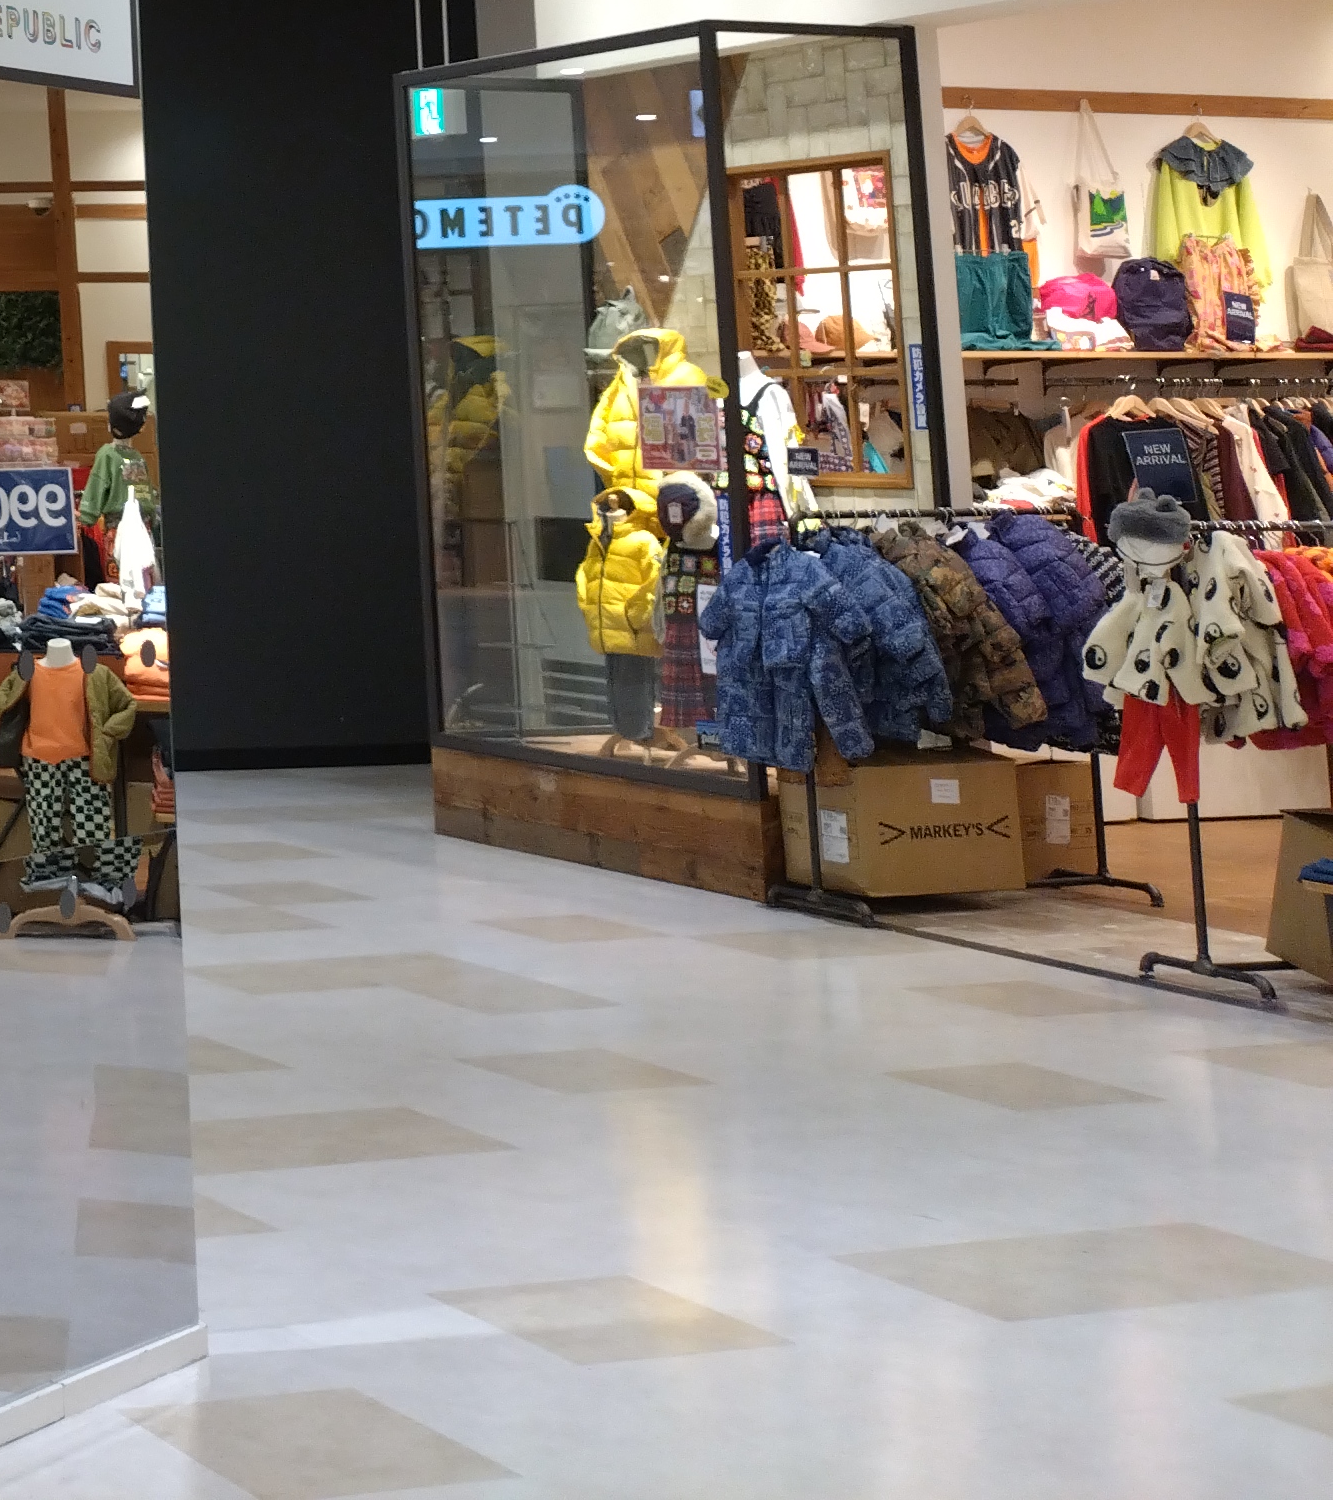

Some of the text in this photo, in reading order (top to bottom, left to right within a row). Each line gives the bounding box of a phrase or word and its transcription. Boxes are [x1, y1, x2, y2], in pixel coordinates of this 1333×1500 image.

[1144, 443, 1171, 454] NEW
[1136, 453, 1188, 466] ARRIVAL
[910, 822, 984, 841] MARKEY'S
